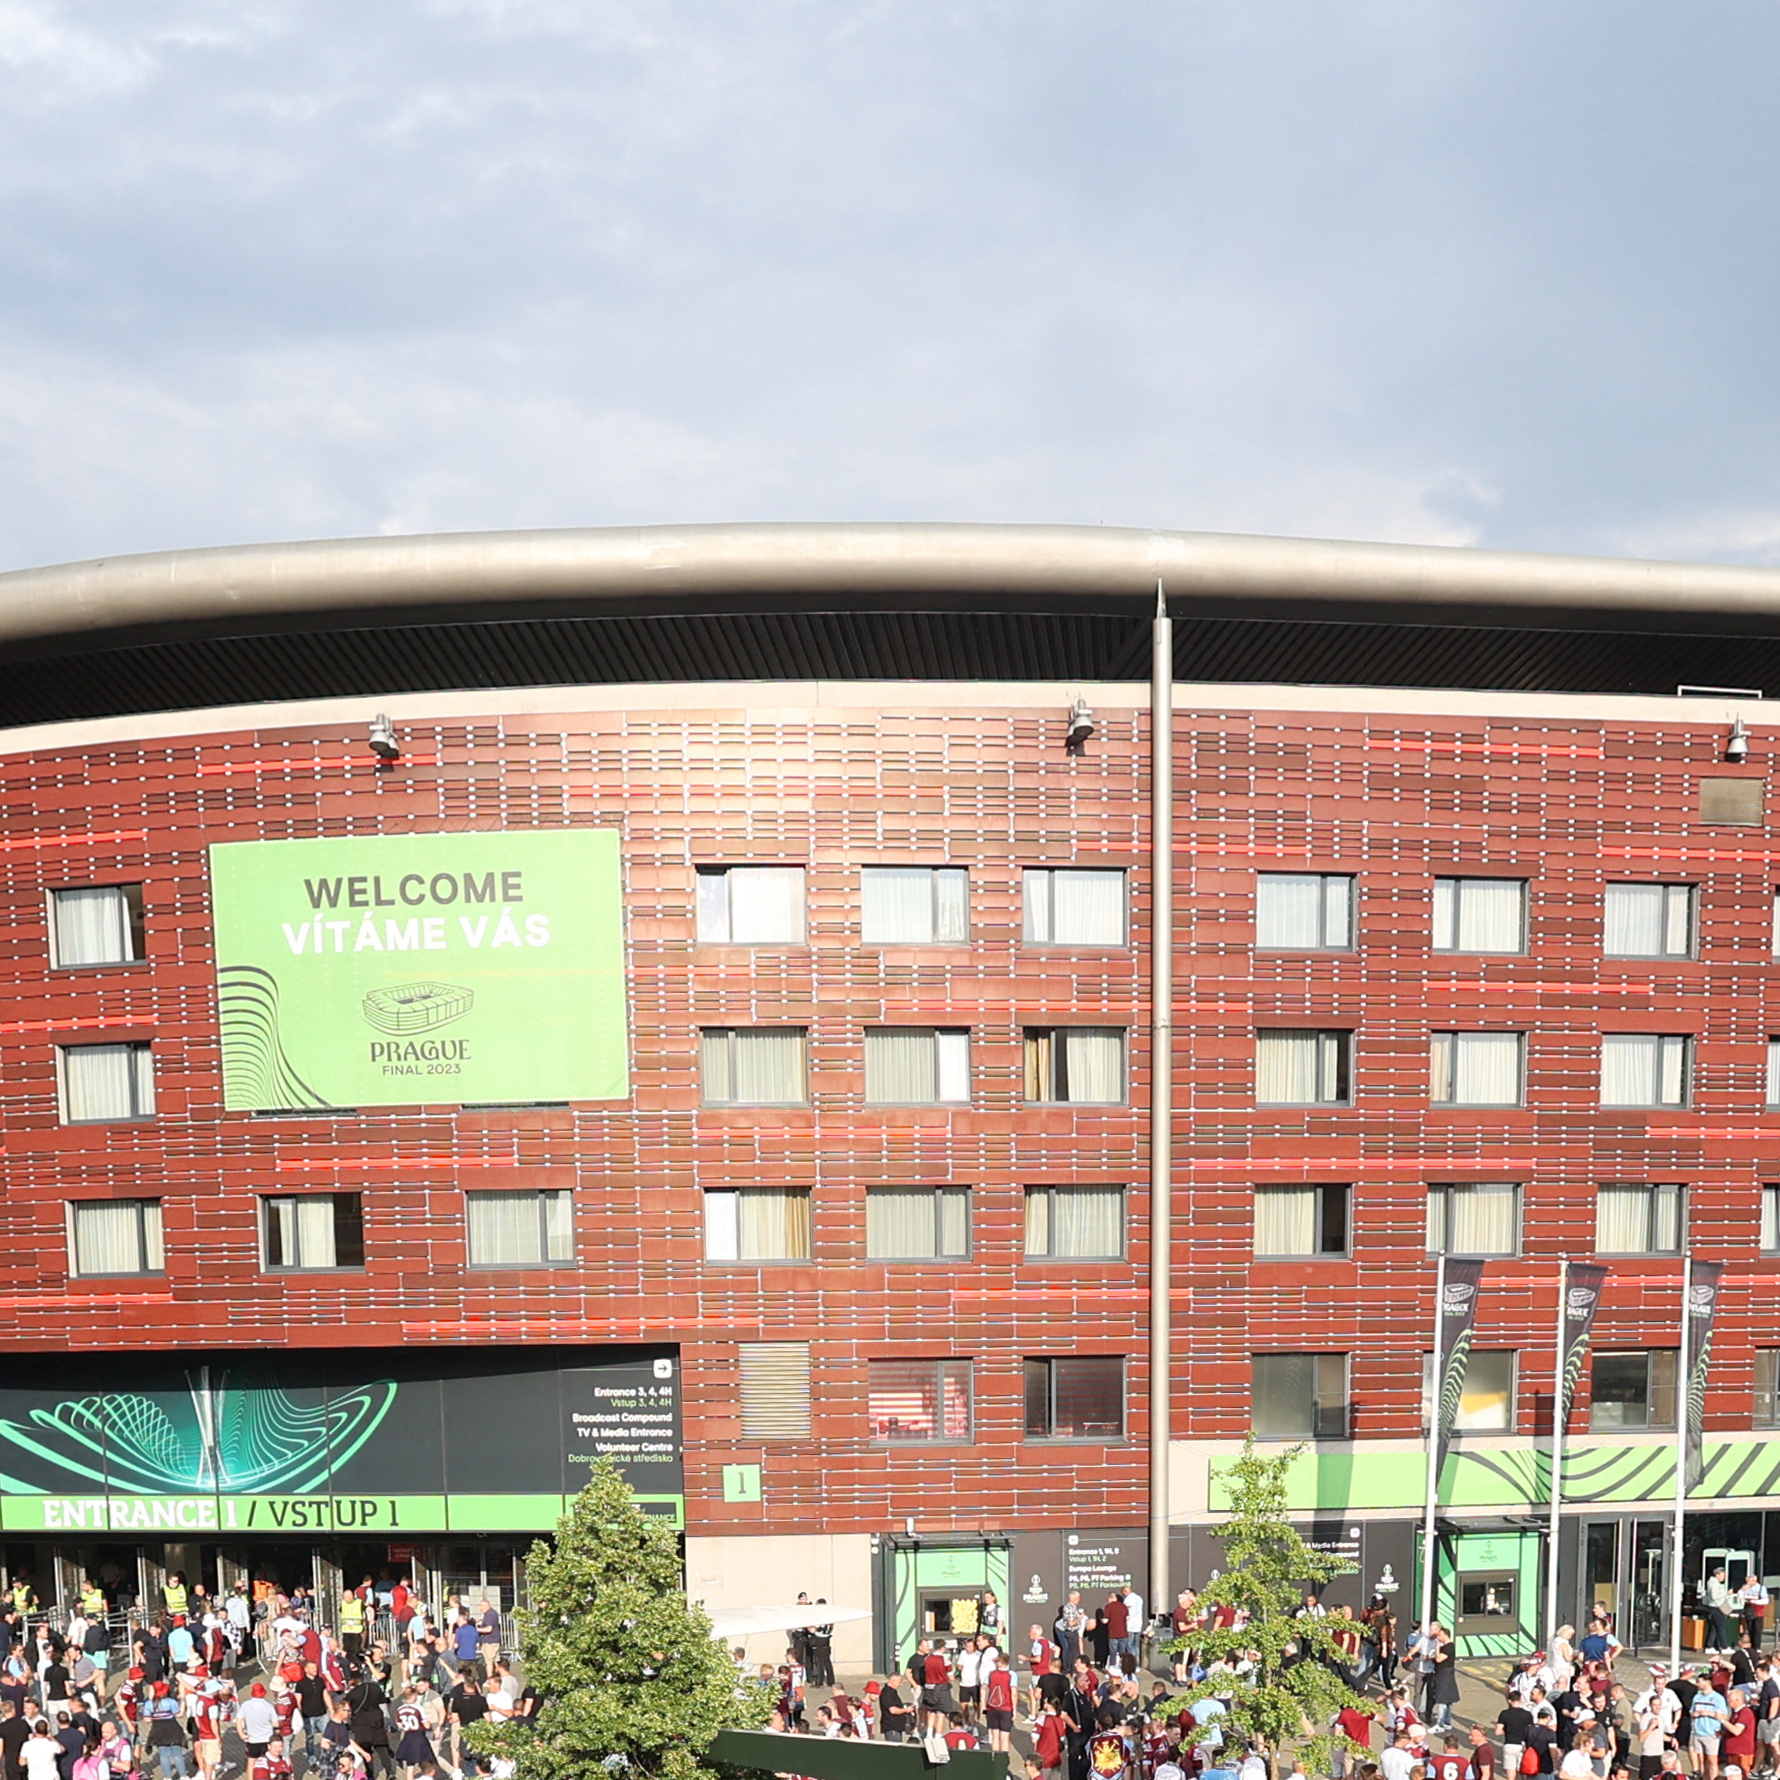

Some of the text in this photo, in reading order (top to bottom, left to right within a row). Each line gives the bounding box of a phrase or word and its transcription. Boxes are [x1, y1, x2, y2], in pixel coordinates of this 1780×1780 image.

[304, 870, 524, 909] WELCOME
[282, 906, 552, 955] VÍTÁME VÁS
[370, 1039, 472, 1063] PRAGUE
[382, 1063, 462, 1076] FINAL 2023
[594, 1387, 636, 1397] Entrance
[659, 1387, 673, 1396] 4H
[610, 1399, 637, 1408] Vstup
[659, 1398, 672, 1407] 4H
[572, 1413, 672, 1424] Broadcast Compound
[577, 1427, 673, 1437] TV & Media Entrance
[595, 1443, 673, 1452] Volunteer Centre
[633, 1453, 673, 1463] středisko
[738, 1471, 747, 1495] 1
[43, 1499, 218, 1529] ENTRANCE
[224, 1499, 238, 1528] 1
[268, 1500, 379, 1528] VSTUP
[388, 1500, 400, 1527] 1
[399, 1715, 418, 1731] 30
